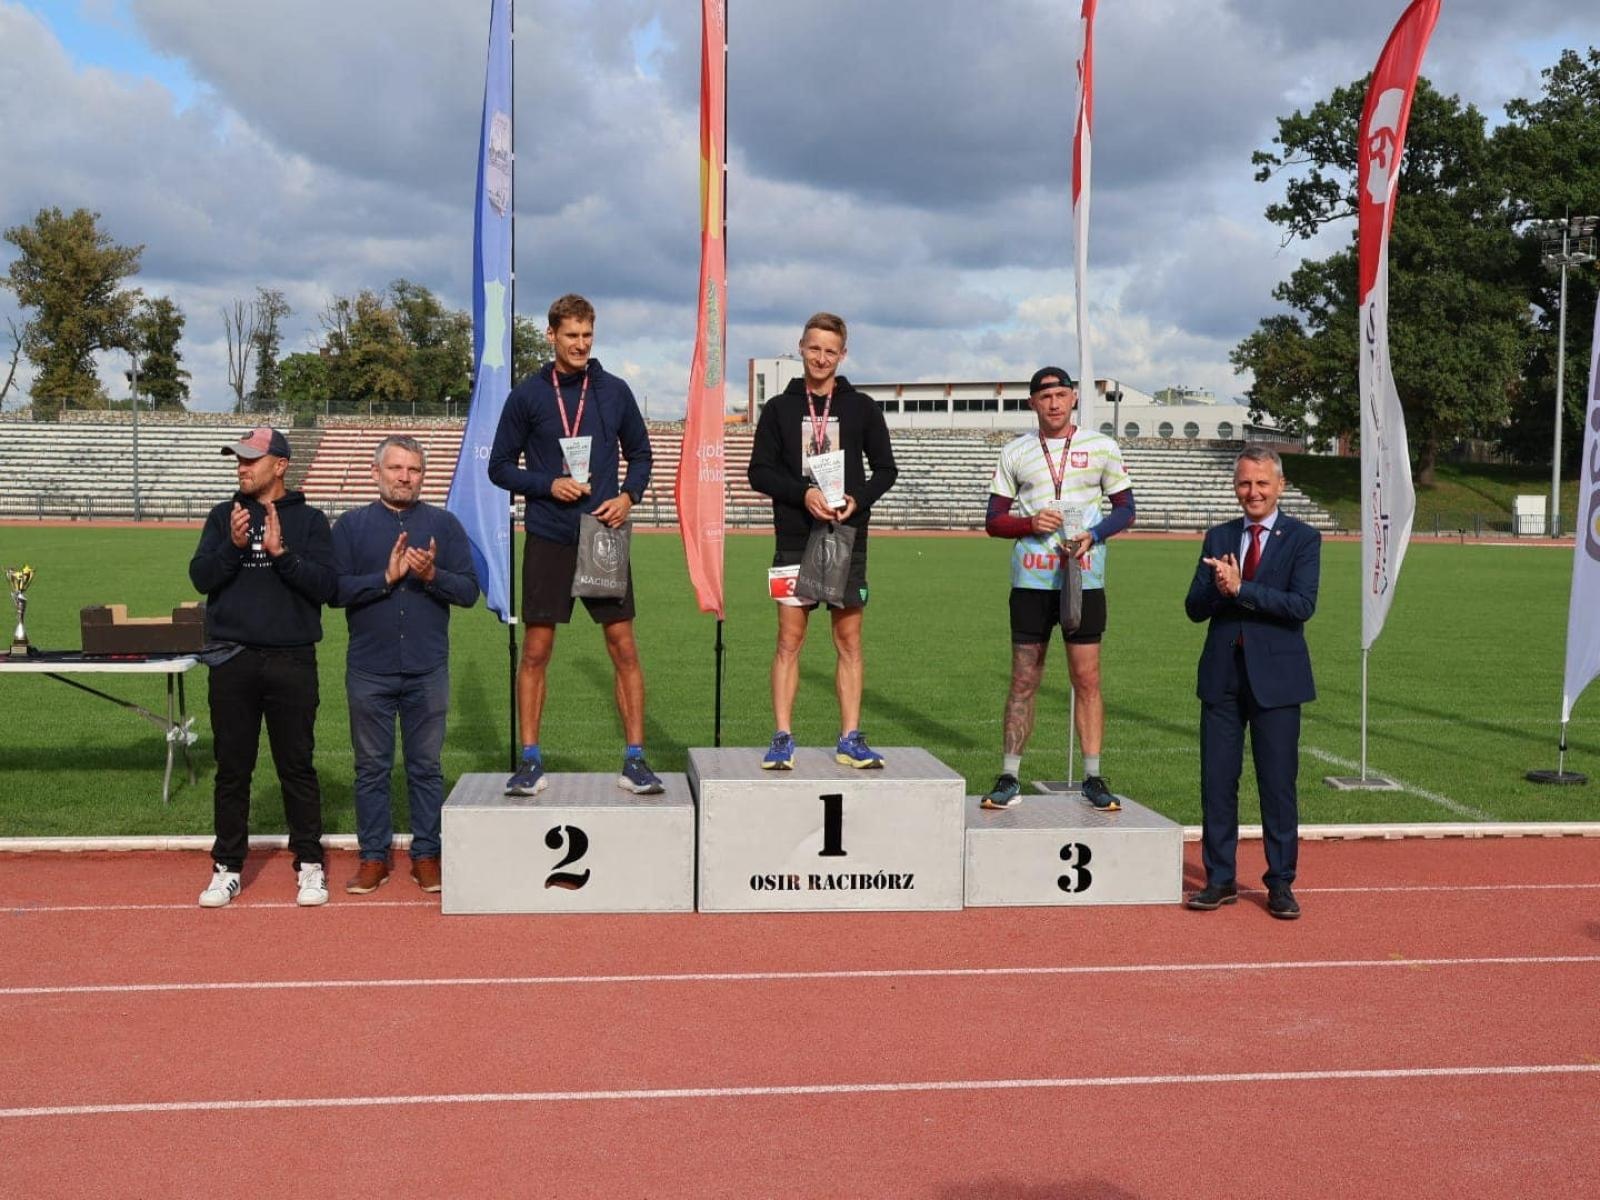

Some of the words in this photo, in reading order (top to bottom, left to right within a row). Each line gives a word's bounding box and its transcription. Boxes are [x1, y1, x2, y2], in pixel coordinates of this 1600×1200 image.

[818, 794, 847, 857] 1
[545, 825, 591, 890] 2
[750, 875, 801, 891] OSIR
[809, 870, 914, 891] RACIBÓRZ
[1057, 843, 1092, 893] 3
